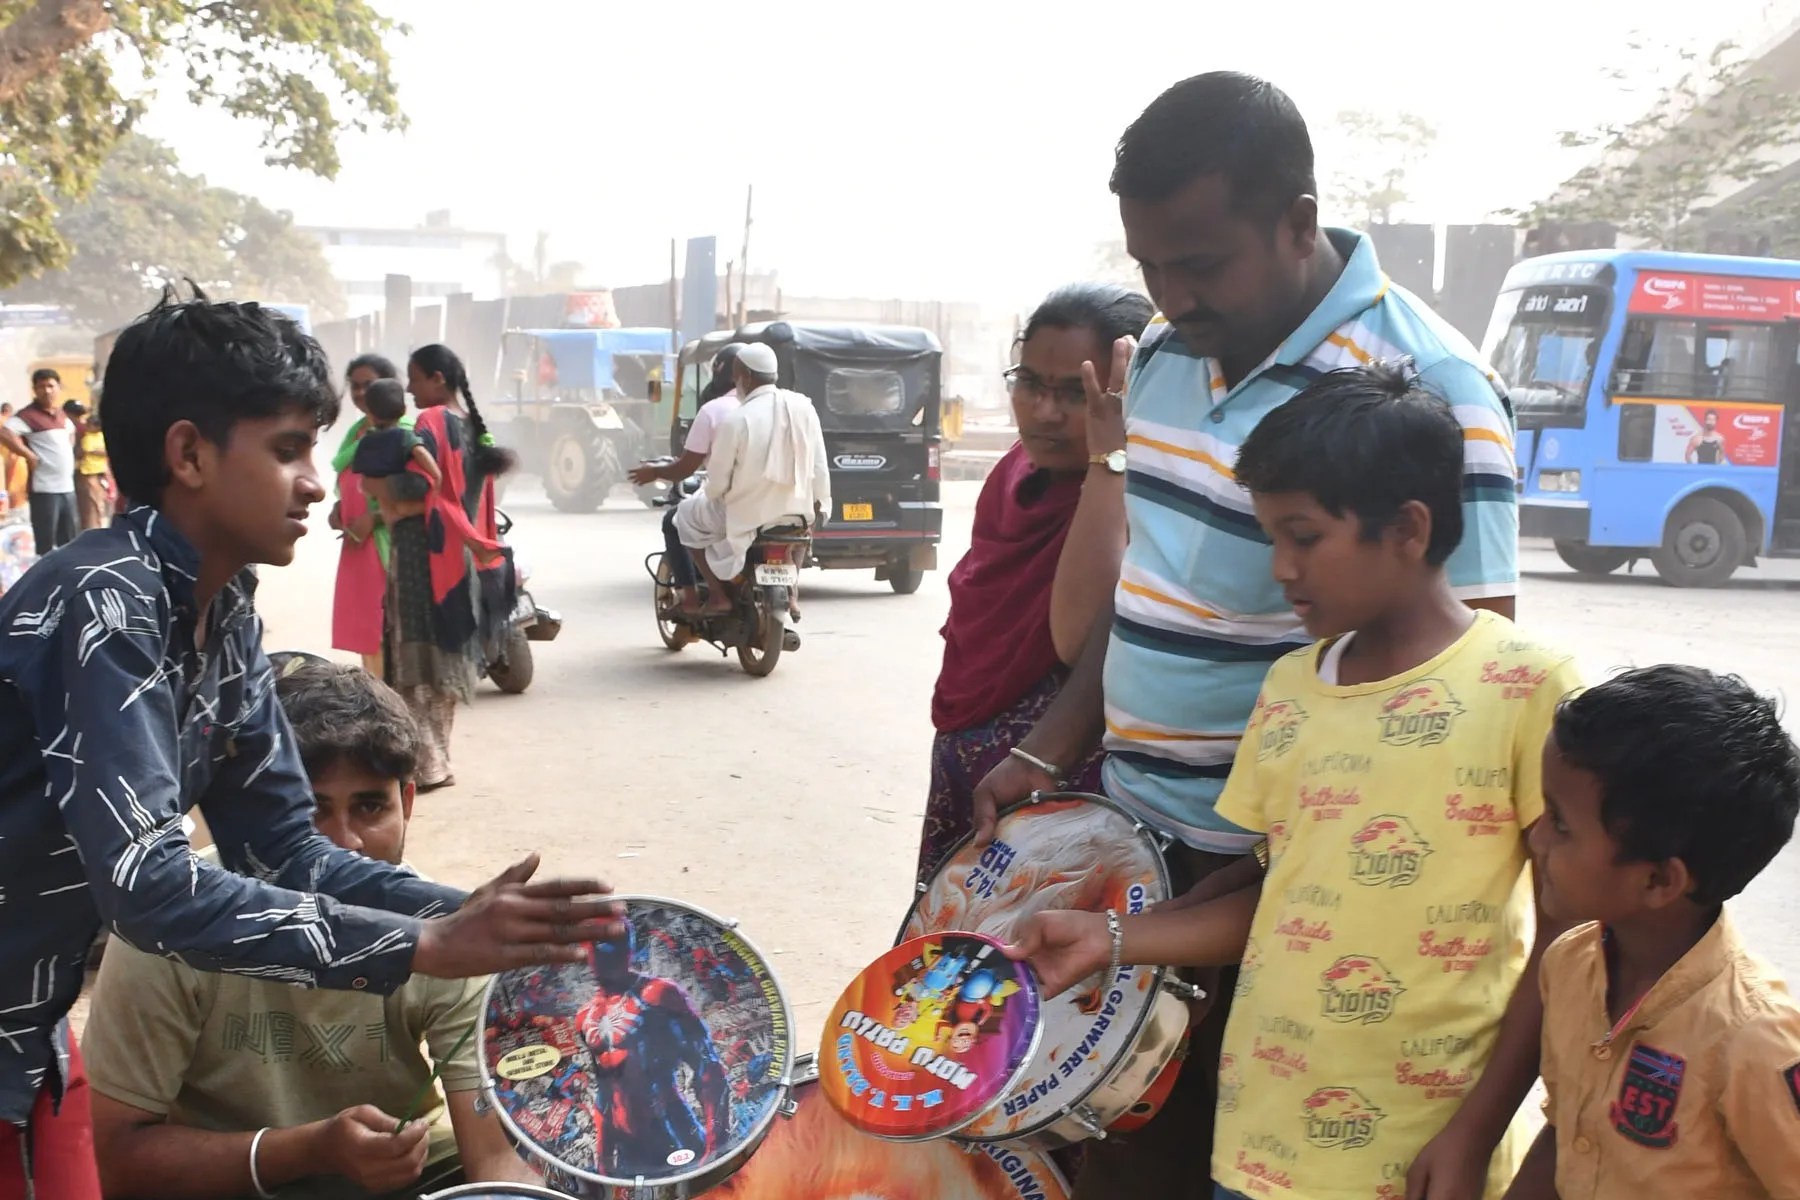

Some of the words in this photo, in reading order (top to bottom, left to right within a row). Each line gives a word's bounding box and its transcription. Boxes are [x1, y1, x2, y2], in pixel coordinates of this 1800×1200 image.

[980, 847, 1011, 878] HD
[840, 1009, 911, 1055] PATLU
[1059, 989, 1123, 1078] GARWARE
[768, 1039, 788, 1079] PAPER
[910, 1046, 978, 1091] MOTU
[1003, 1073, 1060, 1117] PAPER
[1621, 1084, 1673, 1121] EST
